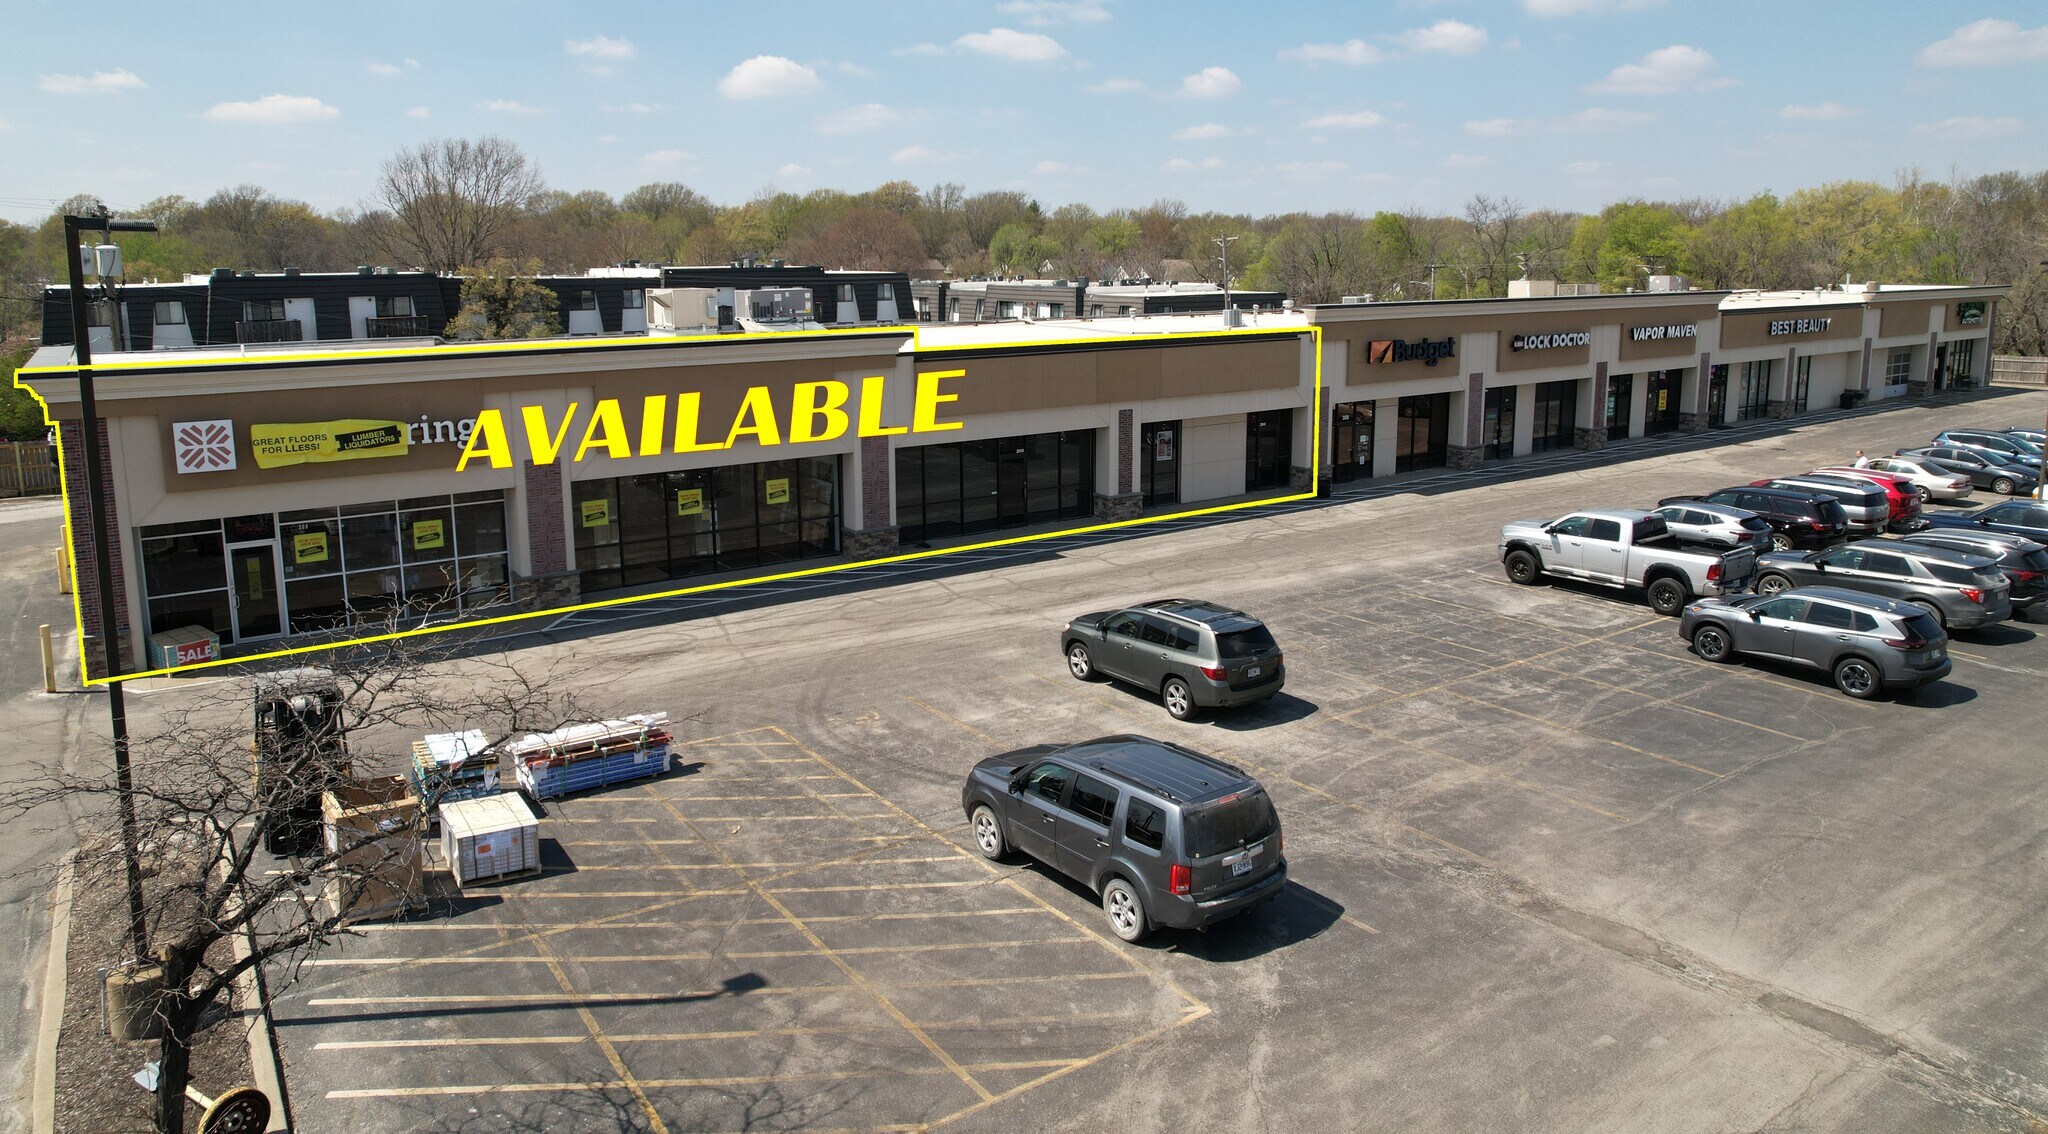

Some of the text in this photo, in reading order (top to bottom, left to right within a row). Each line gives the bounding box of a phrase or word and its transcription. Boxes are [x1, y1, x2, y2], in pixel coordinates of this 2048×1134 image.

[1632, 324, 1698, 341] VAPOR MAVEN
[1770, 318, 1832, 336] BEST BEAUTY
[1523, 334, 1551, 350] LOCK
[1552, 332, 1591, 348] DOCTOR
[1394, 336, 1456, 367] Budget
[252, 433, 328, 447] GREAT FLOORS
[344, 434, 396, 450] LIQUIDATORS
[351, 429, 386, 442] LUMBER
[262, 443, 320, 455] FOR LLESS!
[177, 645, 213, 665] SALE
